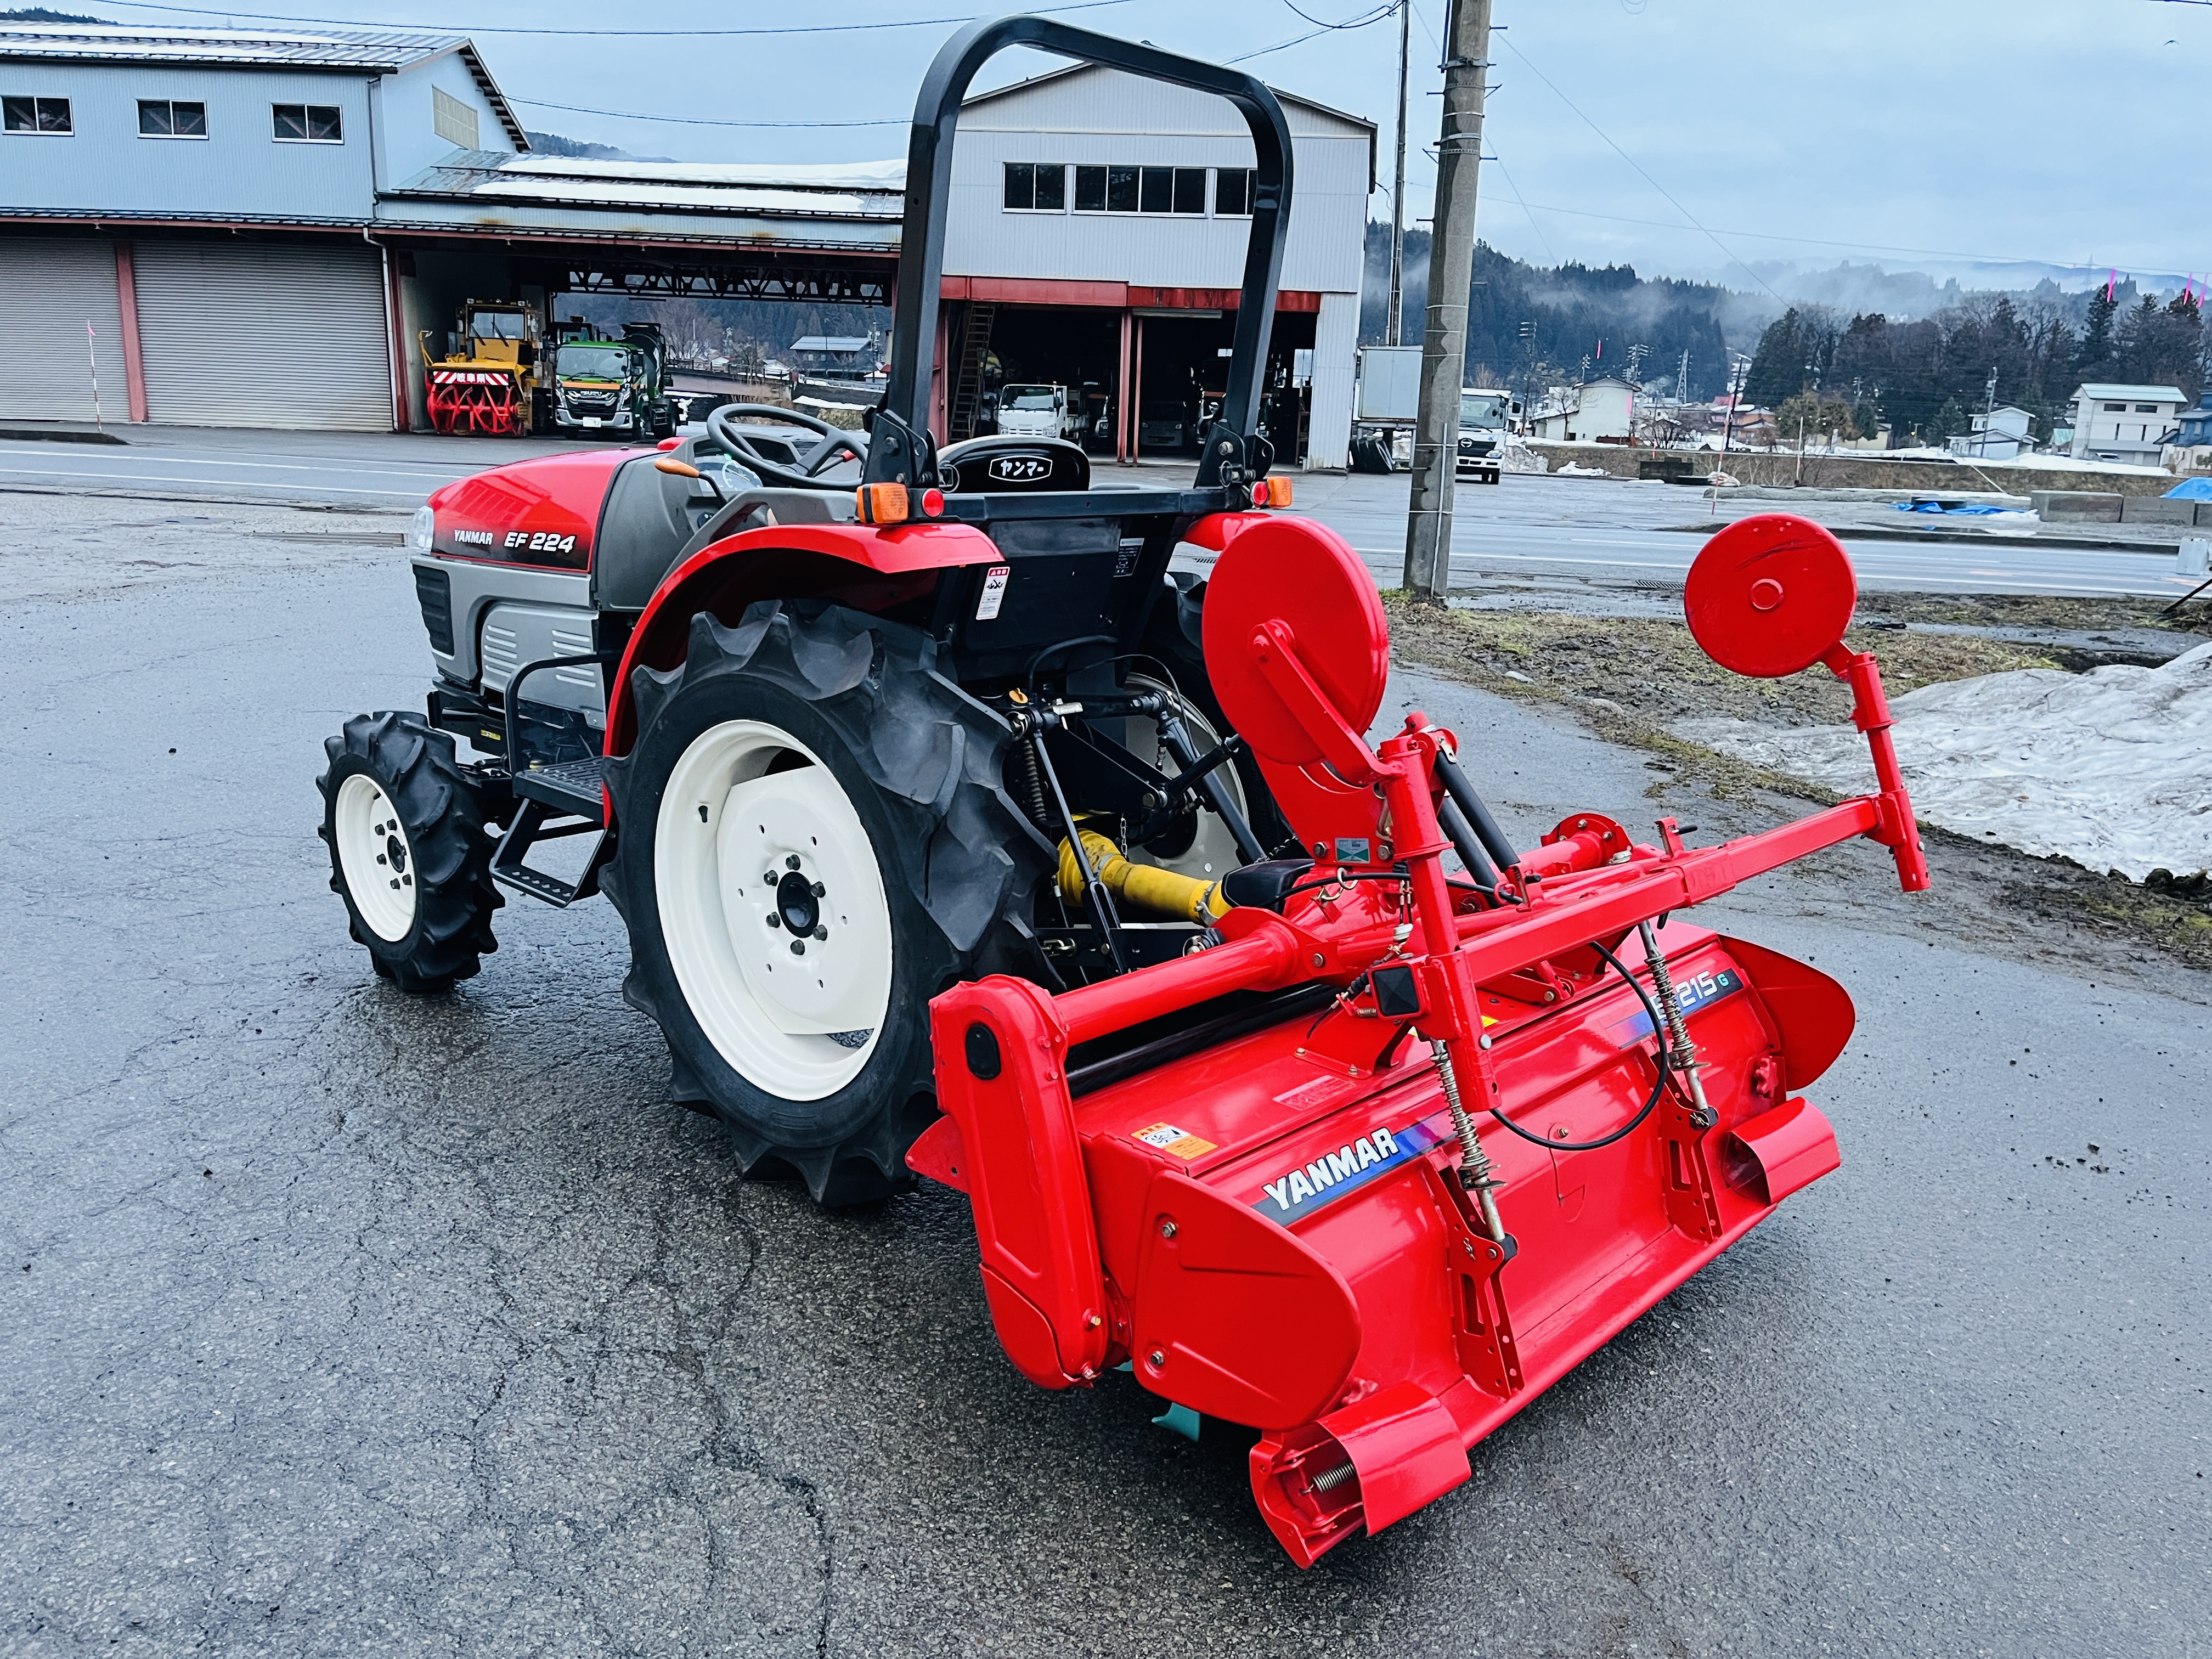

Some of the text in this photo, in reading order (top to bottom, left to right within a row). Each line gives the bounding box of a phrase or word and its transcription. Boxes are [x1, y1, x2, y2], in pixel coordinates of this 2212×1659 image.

[1001, 460, 1043, 476] ヤンマー
[454, 529, 575, 553] YANMAR EF 224
[1262, 1127, 1398, 1211] YANMAR
